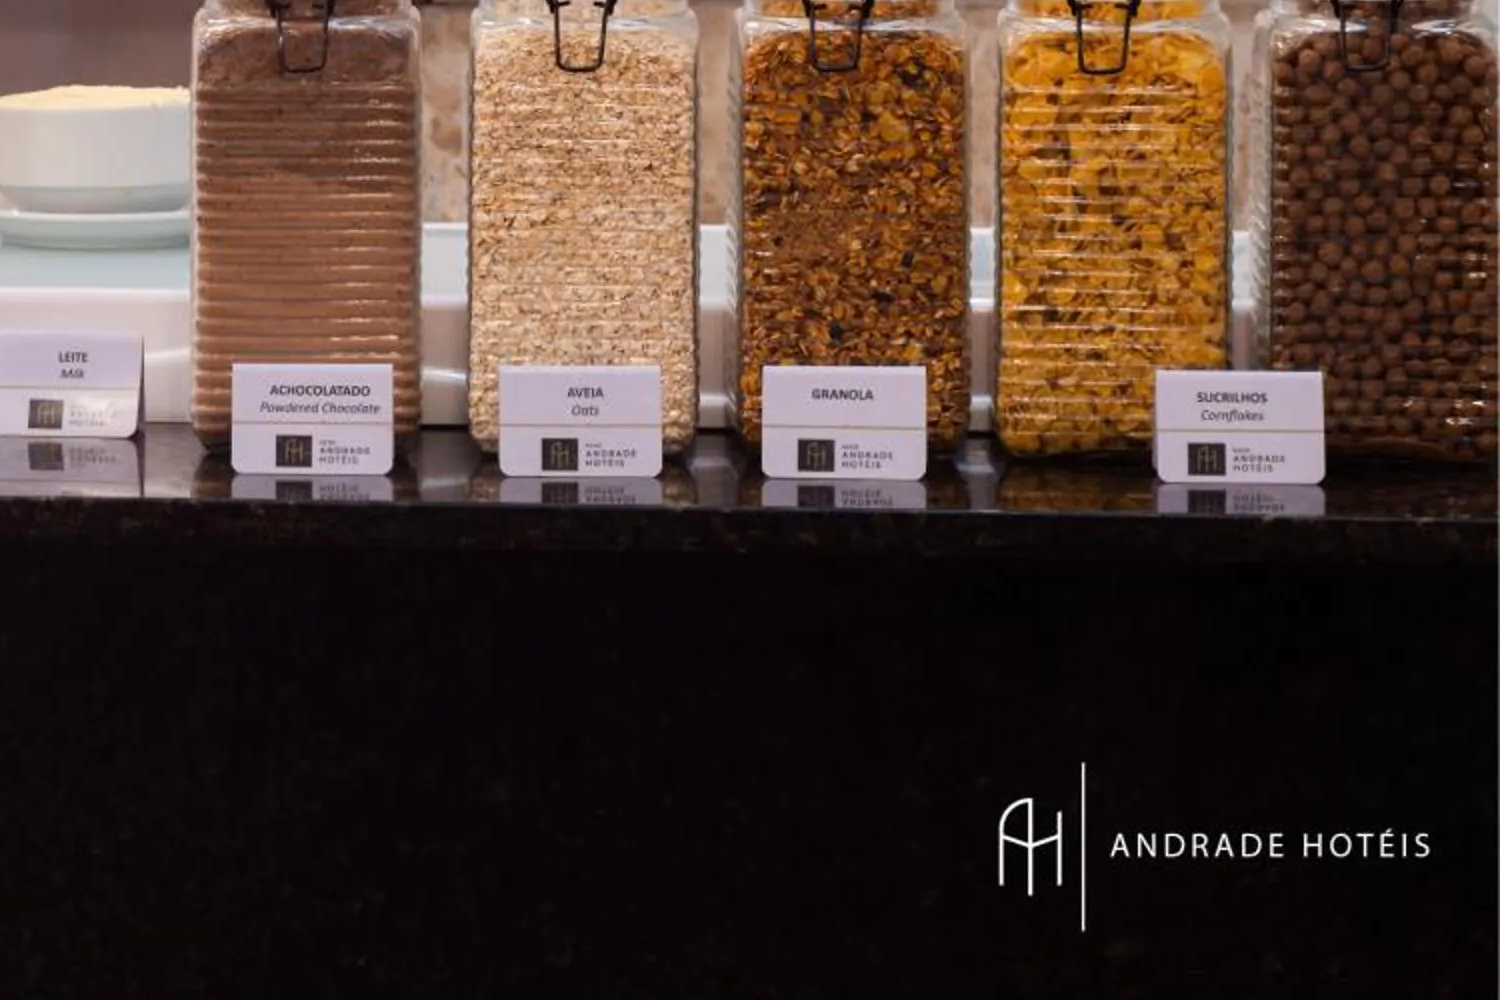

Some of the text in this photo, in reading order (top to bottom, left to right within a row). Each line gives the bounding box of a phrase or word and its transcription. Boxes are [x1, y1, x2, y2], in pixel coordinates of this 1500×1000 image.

[58, 351, 88, 363] LEITE
[269, 385, 371, 397] ACHOCOLATADO
[567, 387, 604, 398] AVEIA
[811, 388, 874, 401] GRANOLA
[1196, 391, 1268, 404] SUCRILHOS
[260, 402, 381, 415] Powdered Chocolate
[1201, 409, 1265, 423] Cornflakes
